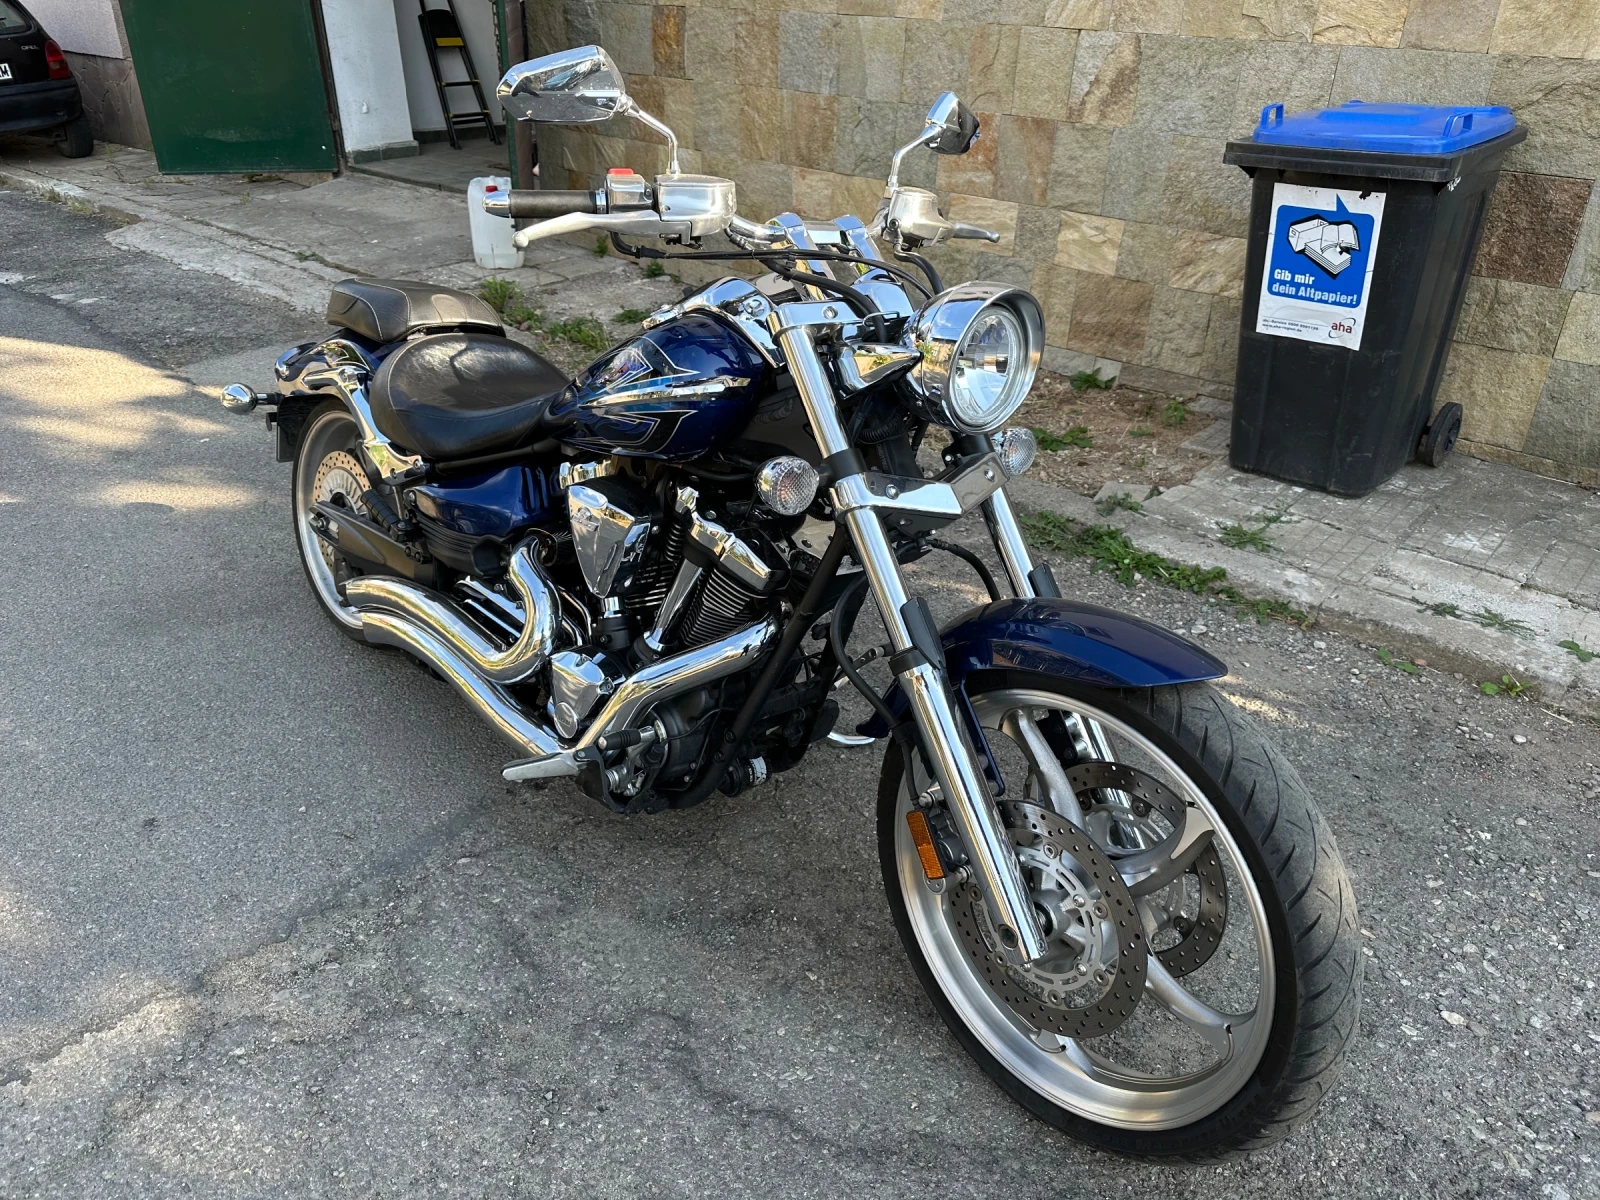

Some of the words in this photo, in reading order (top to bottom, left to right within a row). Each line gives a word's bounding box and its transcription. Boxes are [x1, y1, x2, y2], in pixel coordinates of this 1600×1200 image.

[1274, 269, 1291, 280] Gib
[1294, 274, 1315, 285] mir
[1272, 282, 1295, 294] dein
[1298, 286, 1357, 304] Altpapier!
[1331, 322, 1353, 334] aha
